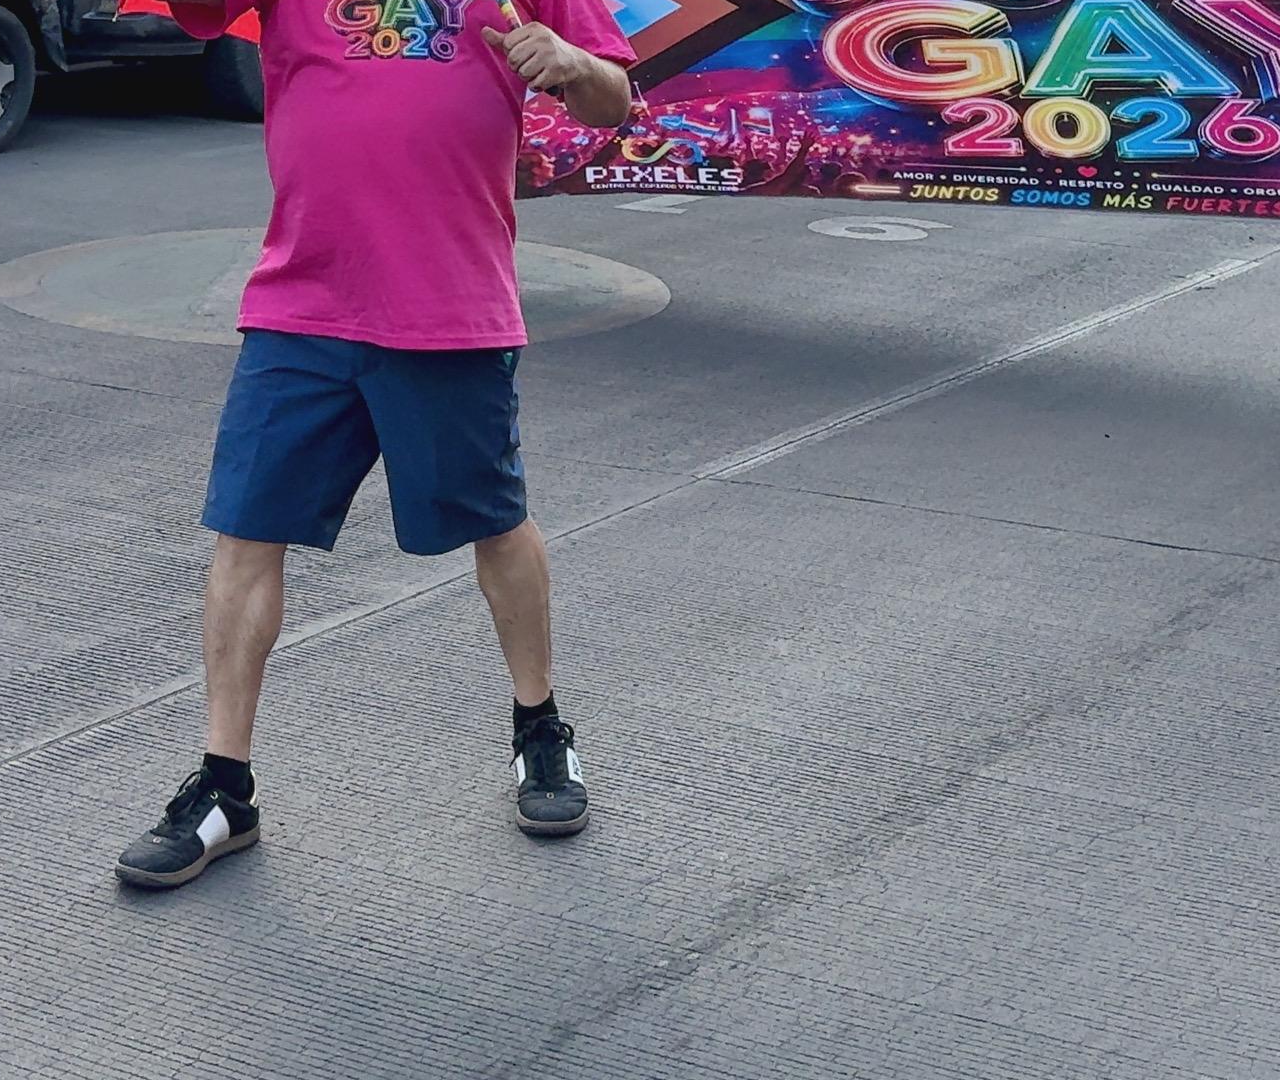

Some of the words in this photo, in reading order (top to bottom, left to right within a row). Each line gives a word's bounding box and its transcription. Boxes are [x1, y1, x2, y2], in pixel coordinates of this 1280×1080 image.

[344, 27, 458, 62] 2026
[585, 165, 745, 185] PIXELES
[892, 171, 934, 181] AMOR
[952, 173, 1040, 186] DIVERSIDAD
[1058, 178, 1125, 191] RESPETO
[1146, 183, 1225, 195] IGUALDAD
[909, 184, 1000, 202] JUNTOS
[1010, 189, 1092, 207] SOMOS
[1102, 191, 1154, 210] MÁS
